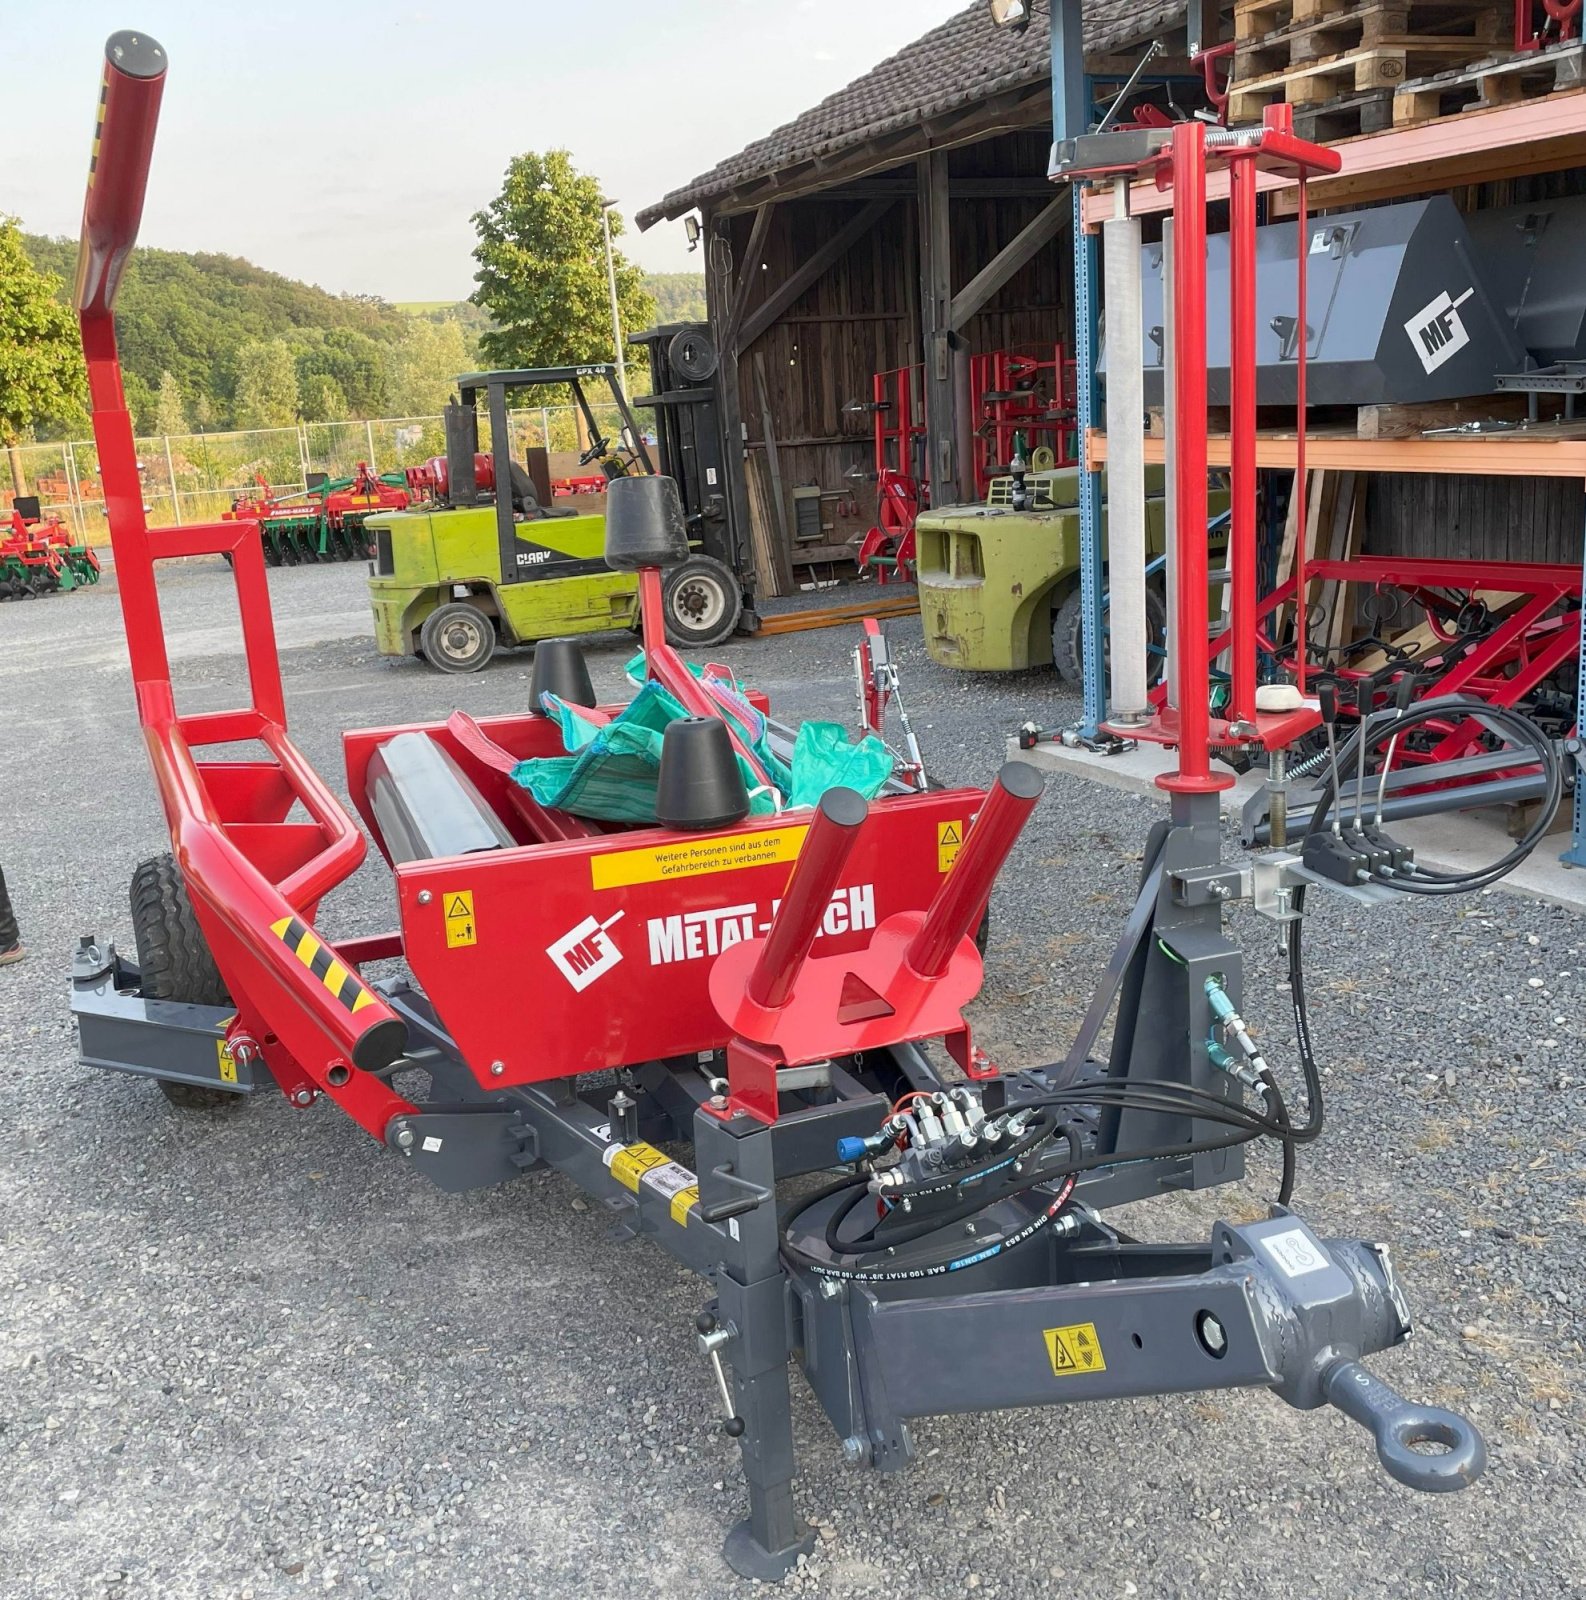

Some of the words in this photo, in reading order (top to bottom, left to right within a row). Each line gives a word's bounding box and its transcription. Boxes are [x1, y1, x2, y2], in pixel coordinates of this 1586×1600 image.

[1418, 304, 1454, 356] MF
[655, 851, 688, 863] Weitere
[690, 846, 727, 858] Personen
[729, 841, 746, 852] sind
[748, 841, 761, 849] aus
[763, 837, 781, 847] dem
[661, 859, 720, 875] Gefahrbereich
[722, 857, 732, 866] zu
[734, 850, 776, 864] verbannen
[563, 931, 604, 976] MF
[1033, 1215, 1048, 1229] DIN
[1021, 1226, 1035, 1238] EN
[1005, 1235, 1021, 1248] 853
[826, 1268, 841, 1277] BAR
[886, 1272, 907, 1280] R1AT
[909, 1270, 924, 1278] 100
[927, 1265, 946, 1275] SAE
